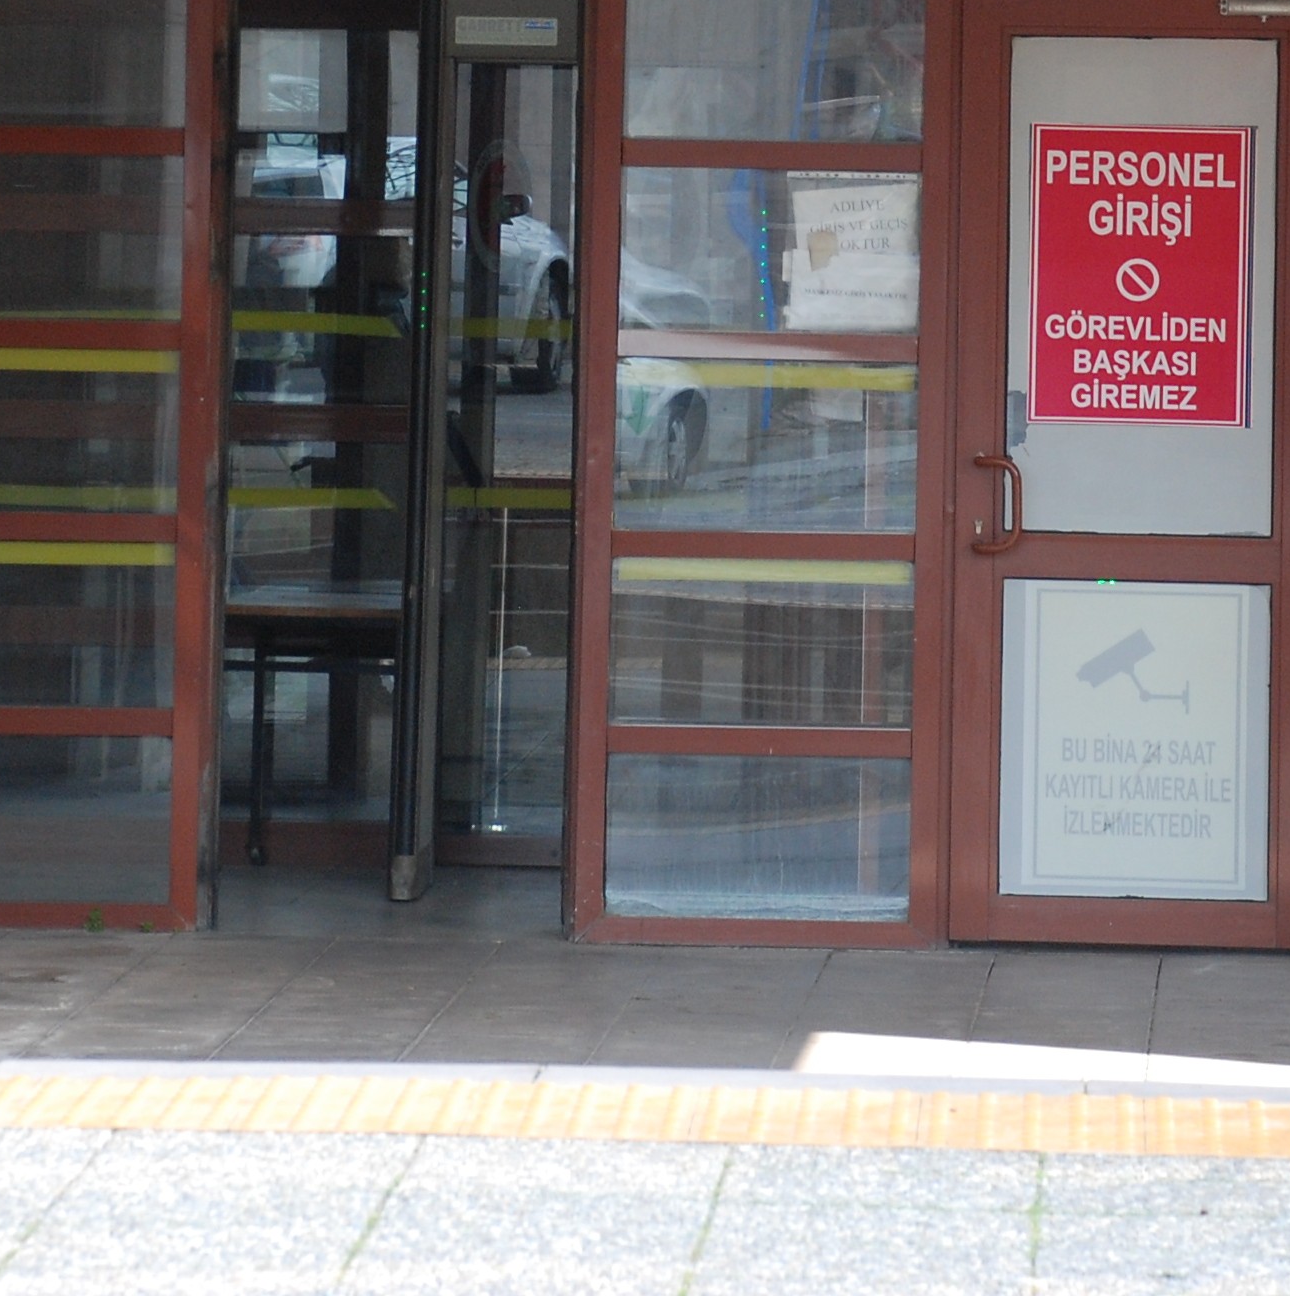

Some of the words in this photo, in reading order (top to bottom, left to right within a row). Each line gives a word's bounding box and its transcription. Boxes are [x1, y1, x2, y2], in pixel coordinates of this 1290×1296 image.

[1045, 150, 1236, 188] PERSONEL
[830, 198, 885, 214] ADLİYE
[1089, 193, 1192, 245] GİRİŞİ
[840, 236, 890, 250] OKTUR
[1045, 310, 1227, 343] GÖREVLİDEN
[1072, 348, 1197, 380] BAŞKASI
[1070, 378, 1197, 411] GİREMEZ
[1061, 738, 1087, 763] BU
[1093, 733, 1137, 764] BİNA
[1167, 740, 1216, 765] SAAT
[1045, 773, 1114, 800] KAYITLI
[1120, 774, 1200, 802] KAMERA
[1204, 772, 1232, 804] İLE
[1063, 805, 1213, 839] İZLENMEKTEDİR
